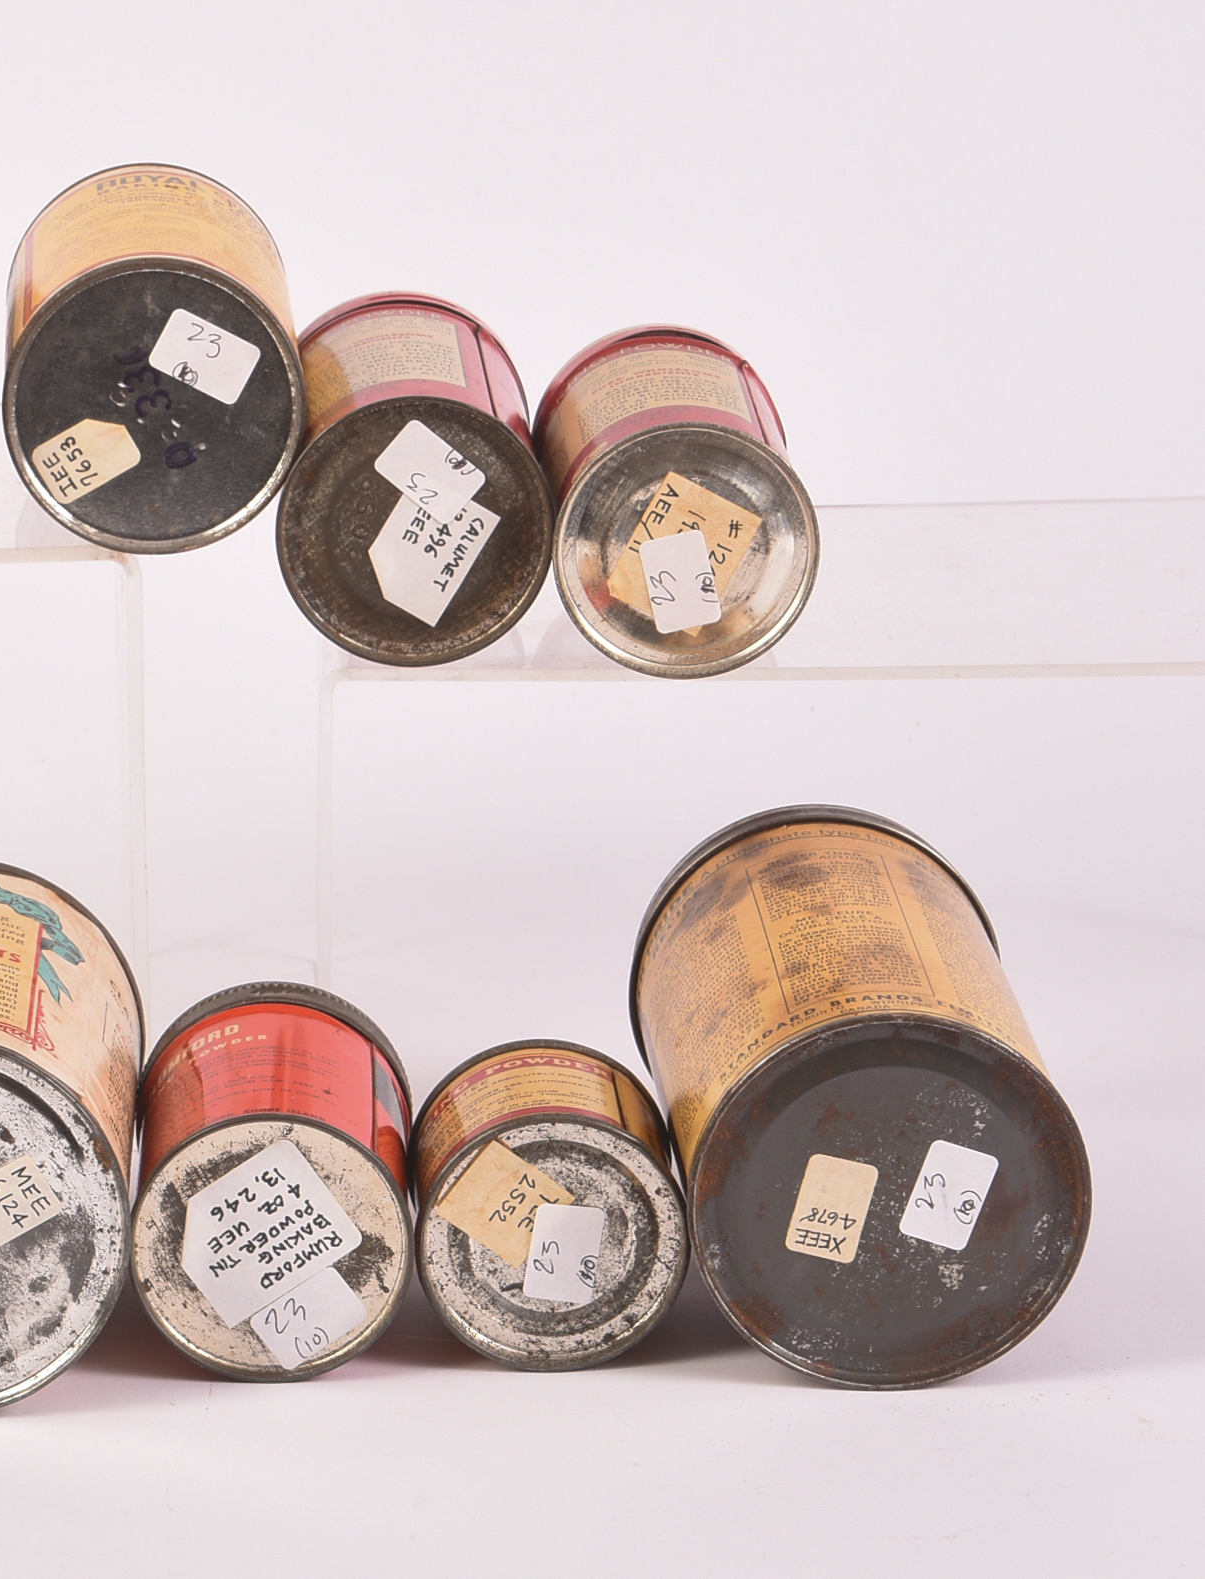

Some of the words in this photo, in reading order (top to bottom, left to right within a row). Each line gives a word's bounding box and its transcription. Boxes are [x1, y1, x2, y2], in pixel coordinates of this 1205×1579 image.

[187, 322, 221, 358] 23
[619, 342, 732, 362] POWDER
[42, 452, 78, 497] IEE
[59, 436, 98, 486] 7653
[406, 472, 438, 505] 23
[433, 517, 484, 593] CALUMET
[650, 571, 677, 606] 23
[819, 828, 860, 839] type
[779, 921, 835, 939] DOUBLE
[840, 1004, 891, 1014] CANADA
[718, 1007, 816, 1081] STANDARD
[830, 994, 924, 1008] BRANDS
[484, 1057, 610, 1078] POWDER
[10, 1165, 52, 1218] MEE
[286, 1183, 302, 1199] 4
[488, 1173, 536, 1222] 2552
[915, 1172, 946, 1210] 23
[238, 1199, 314, 1255] POWDER
[799, 1206, 857, 1230] 4678
[207, 1220, 251, 1254] UEE
[257, 1213, 332, 1266] BAKING
[795, 1228, 847, 1255] XEEE
[208, 1253, 242, 1278] TIN
[259, 1230, 344, 1290] RUMFORD
[533, 1240, 560, 1275] 23
[264, 1298, 307, 1335] 23
[294, 1326, 330, 1359] (10)
